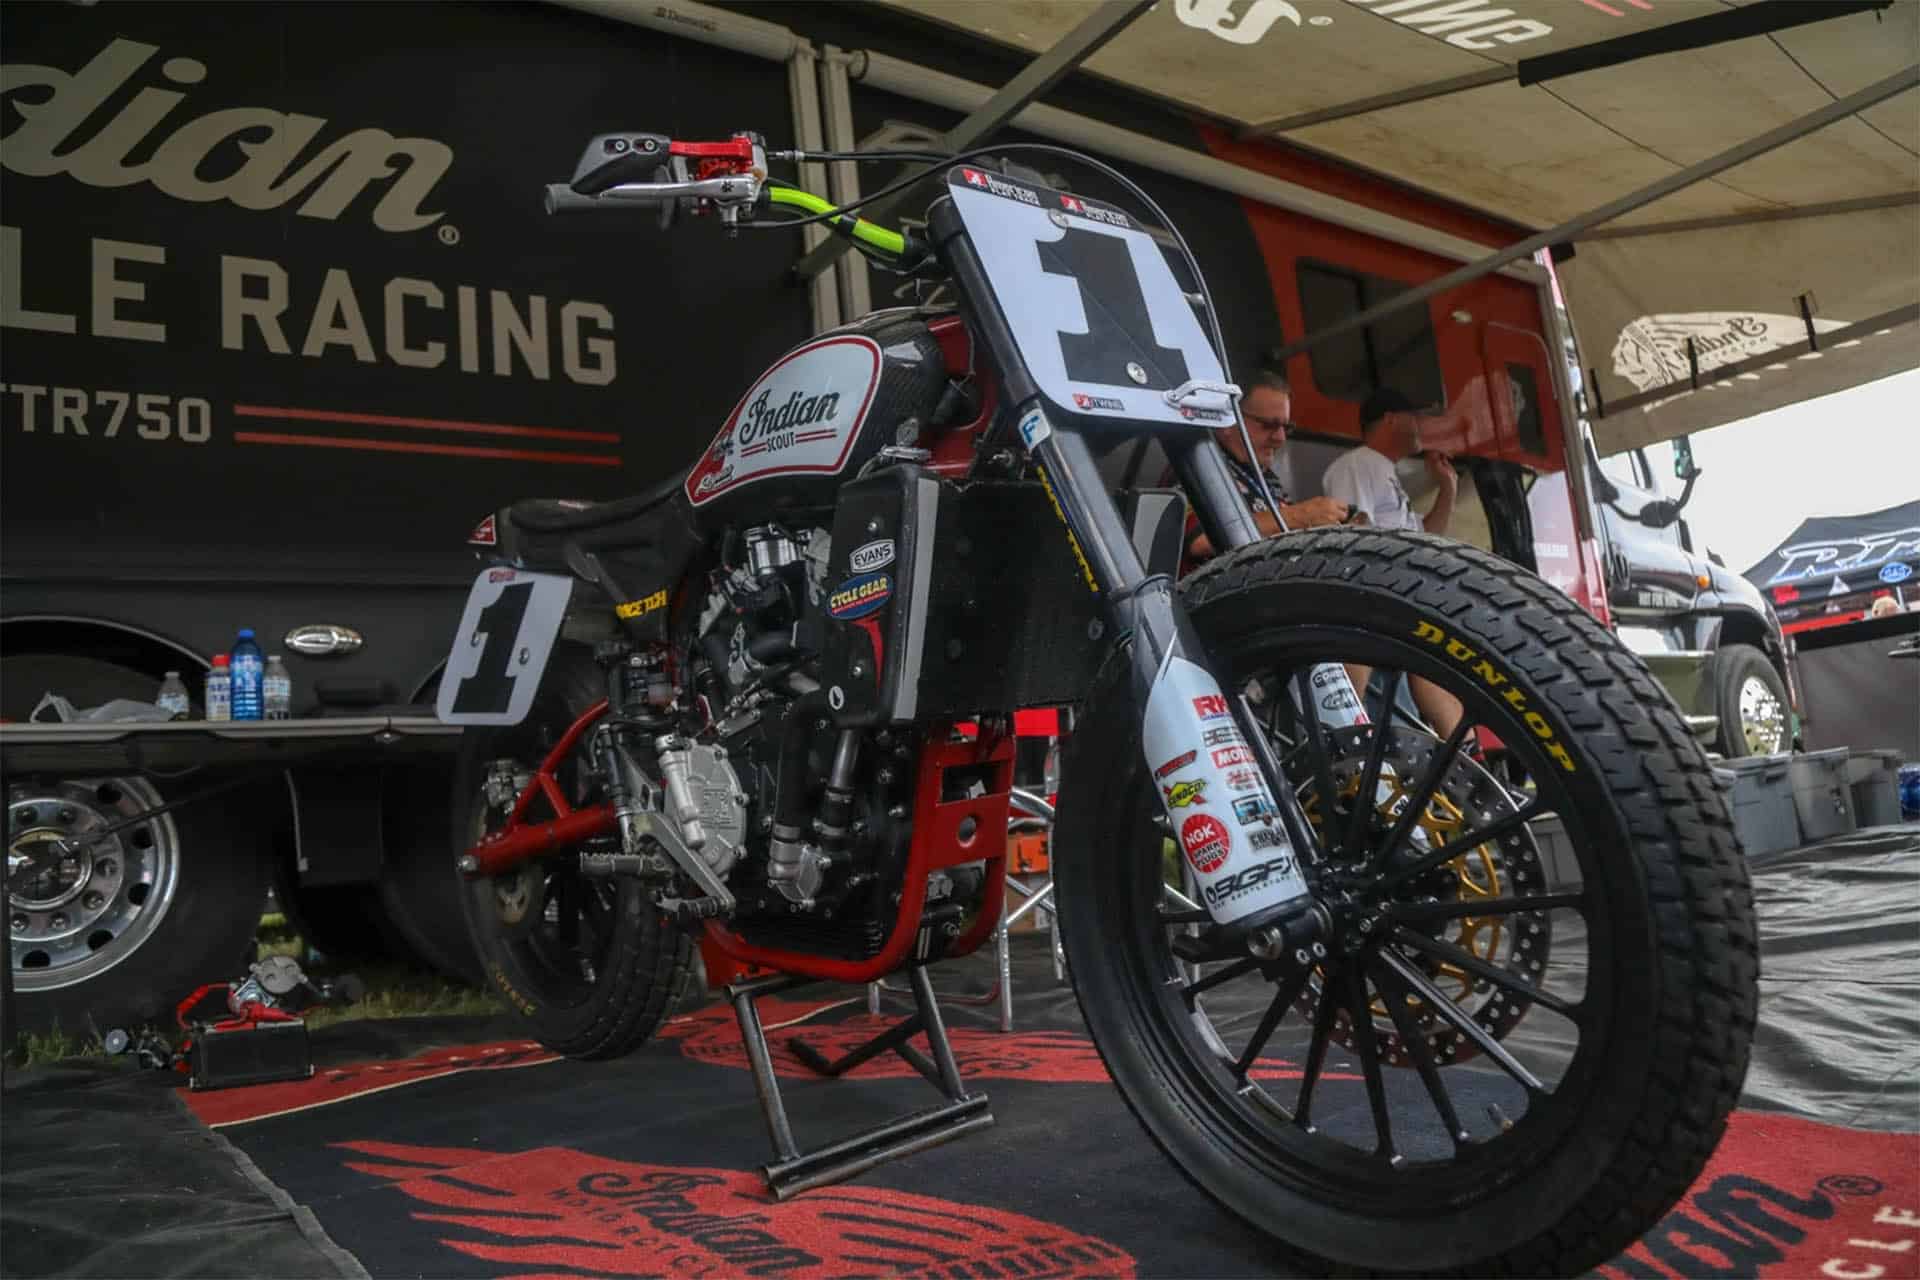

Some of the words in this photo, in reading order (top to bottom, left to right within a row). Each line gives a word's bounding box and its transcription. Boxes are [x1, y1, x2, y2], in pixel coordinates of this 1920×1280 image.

[220, 254, 617, 386] RACING
[1035, 226, 1192, 392] 1
[0, 382, 212, 443] TR750
[739, 388, 840, 445] Indian
[766, 431, 796, 453] SCOUT
[854, 544, 891, 567] EVANS
[831, 588, 858, 609] CYCLE
[859, 577, 888, 600] GEAR
[451, 581, 535, 714] 1
[1411, 620, 1577, 772] DUNLOP
[1185, 822, 1216, 846] NGK
